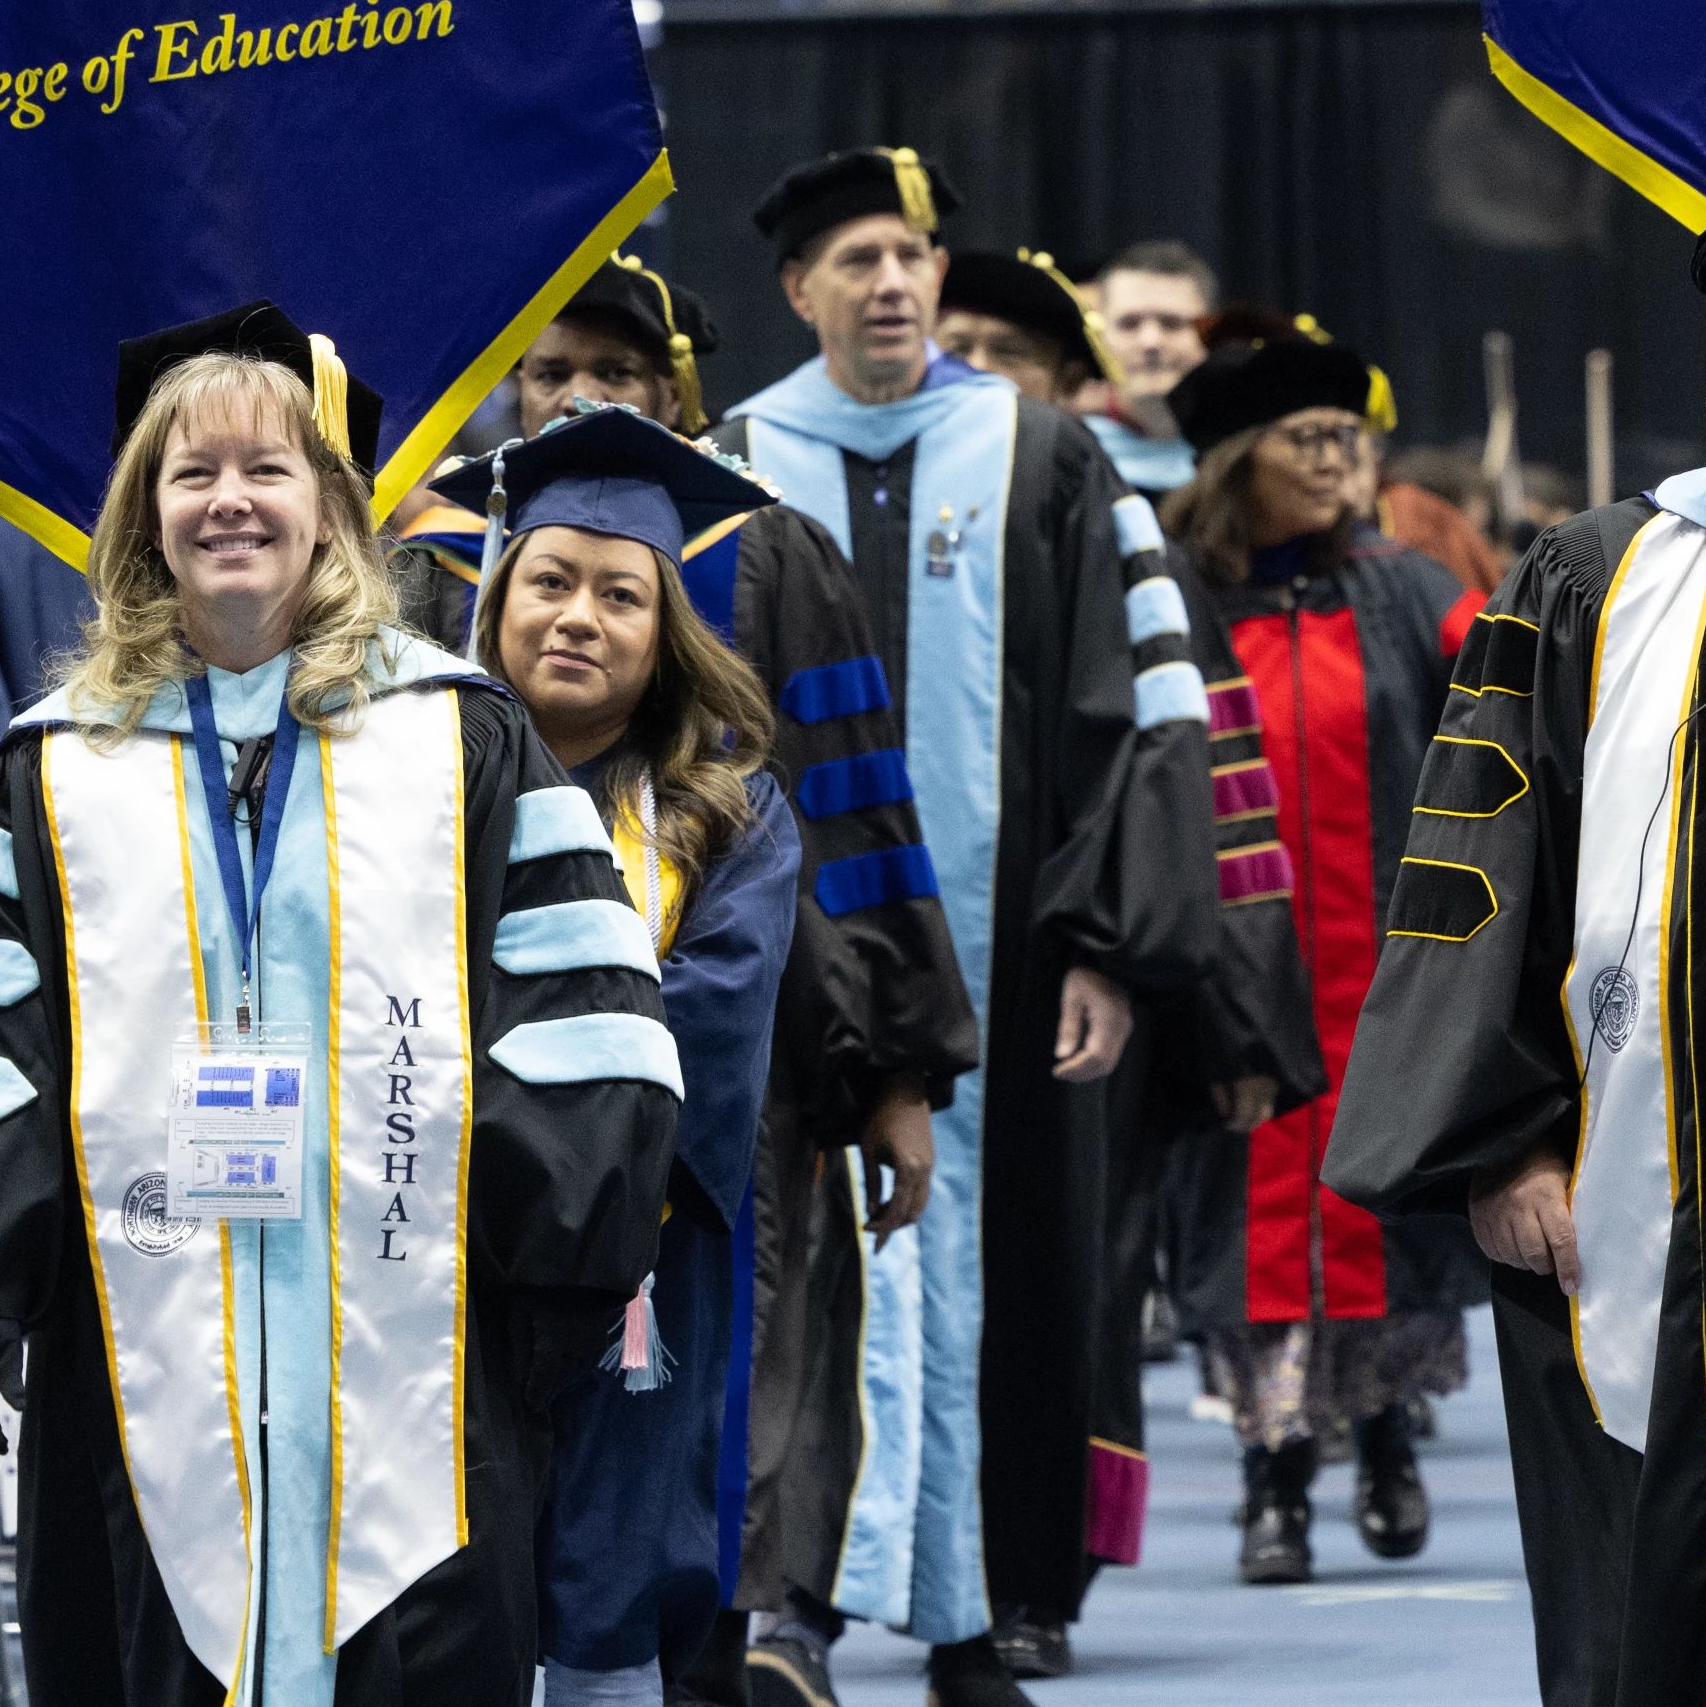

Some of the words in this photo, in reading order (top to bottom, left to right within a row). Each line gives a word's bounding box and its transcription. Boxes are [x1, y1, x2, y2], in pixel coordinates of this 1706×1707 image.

[82, 28, 143, 114] of
[376, 995, 423, 1261] MARSHAL
[138, 1179, 166, 1195] ARIZON
